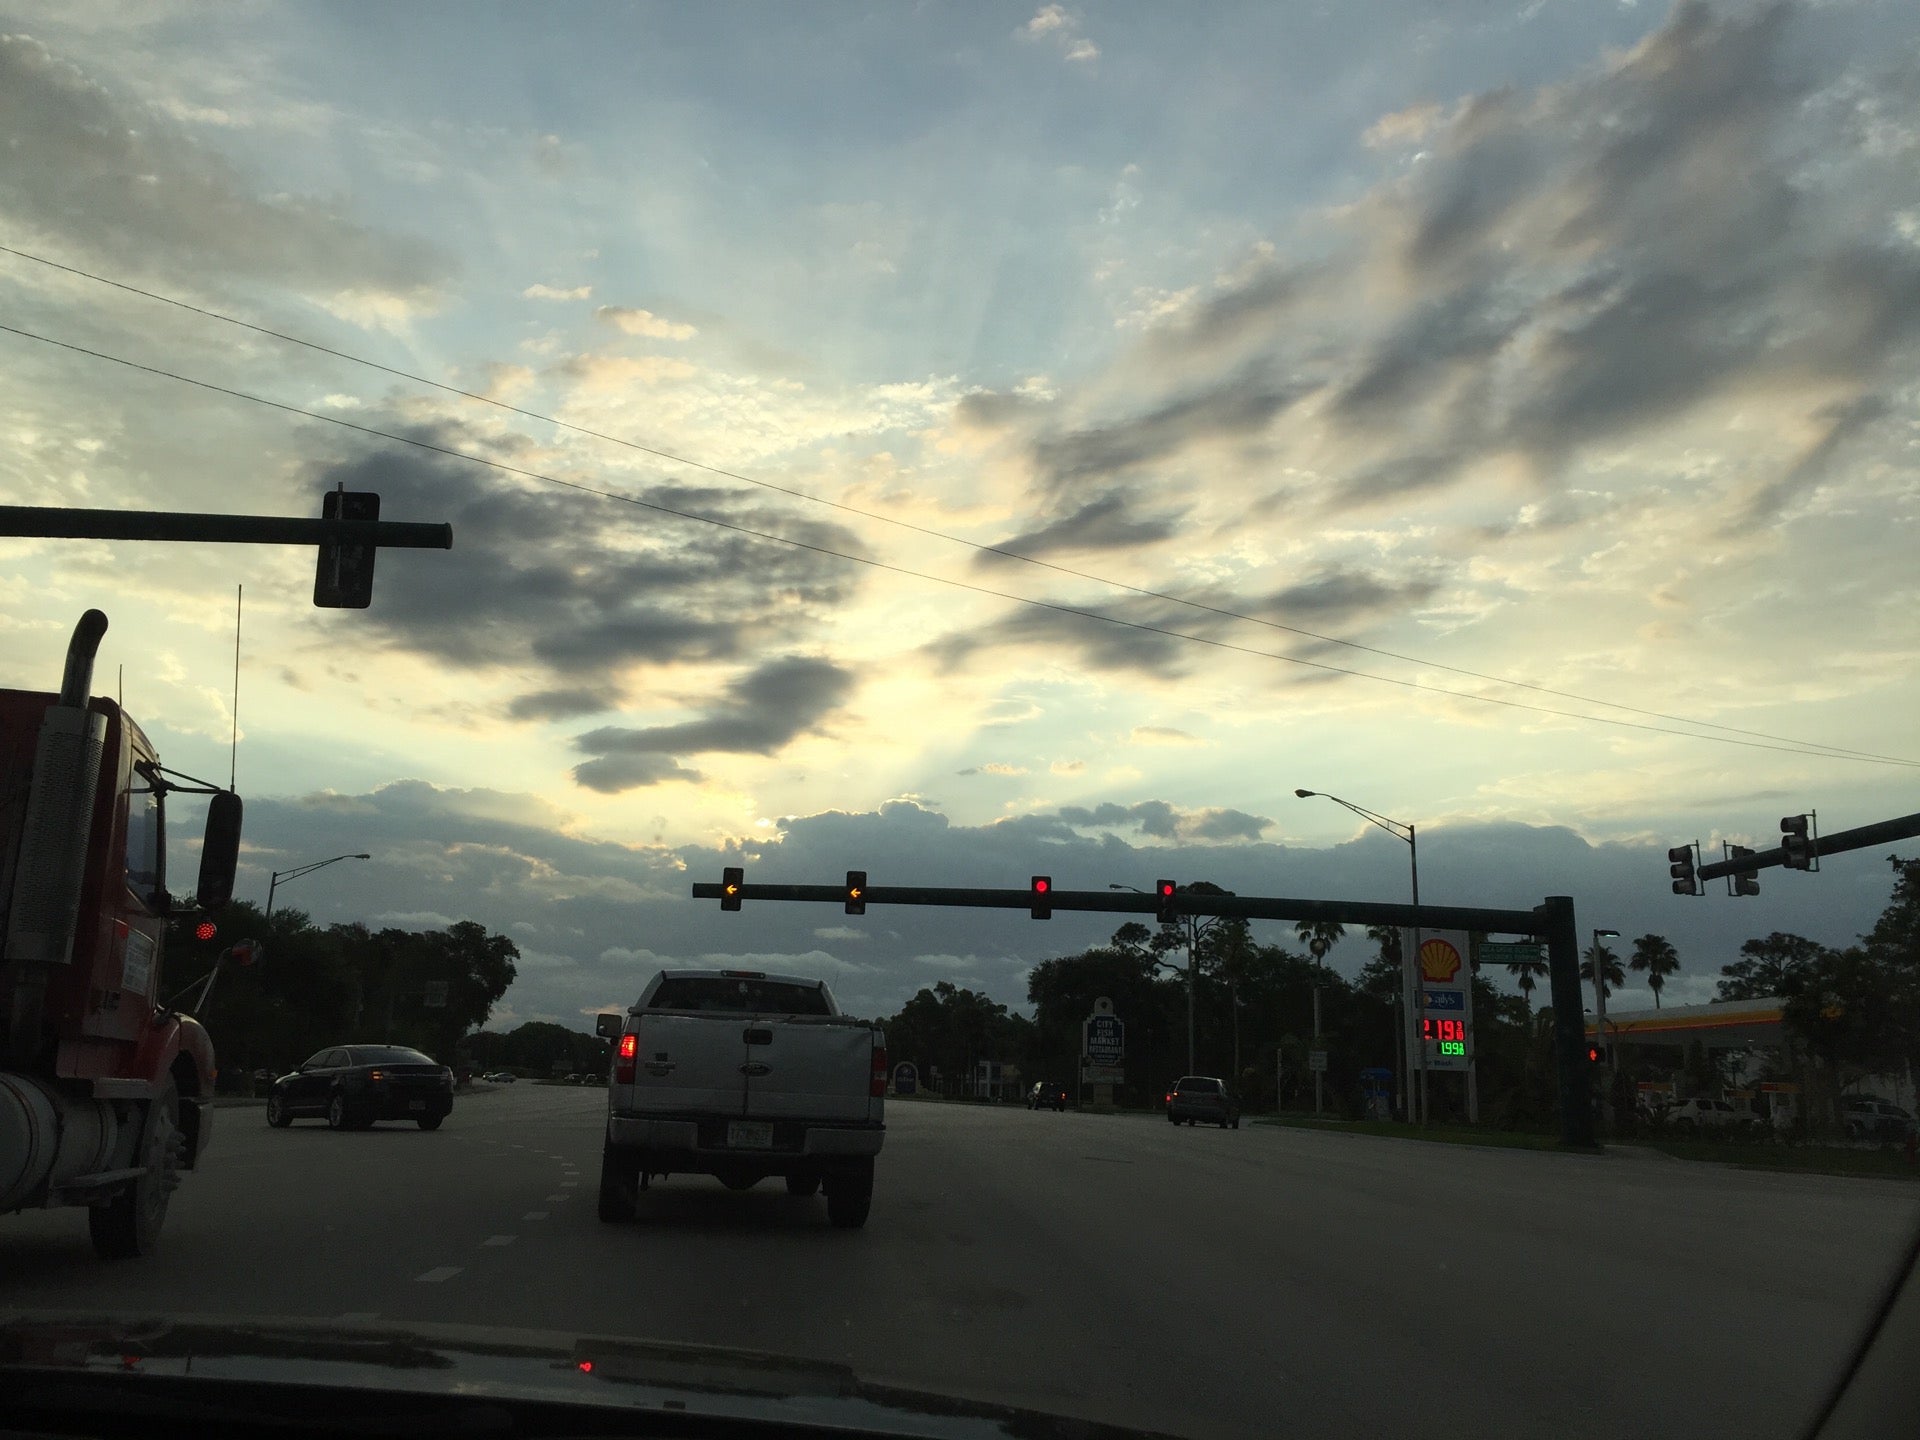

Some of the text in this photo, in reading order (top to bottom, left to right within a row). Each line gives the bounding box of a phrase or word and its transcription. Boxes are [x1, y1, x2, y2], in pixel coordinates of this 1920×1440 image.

[1096, 1020, 1113, 1028] CITY
[1096, 1028, 1114, 1036] FISH
[1090, 1036, 1119, 1045] MARKET
